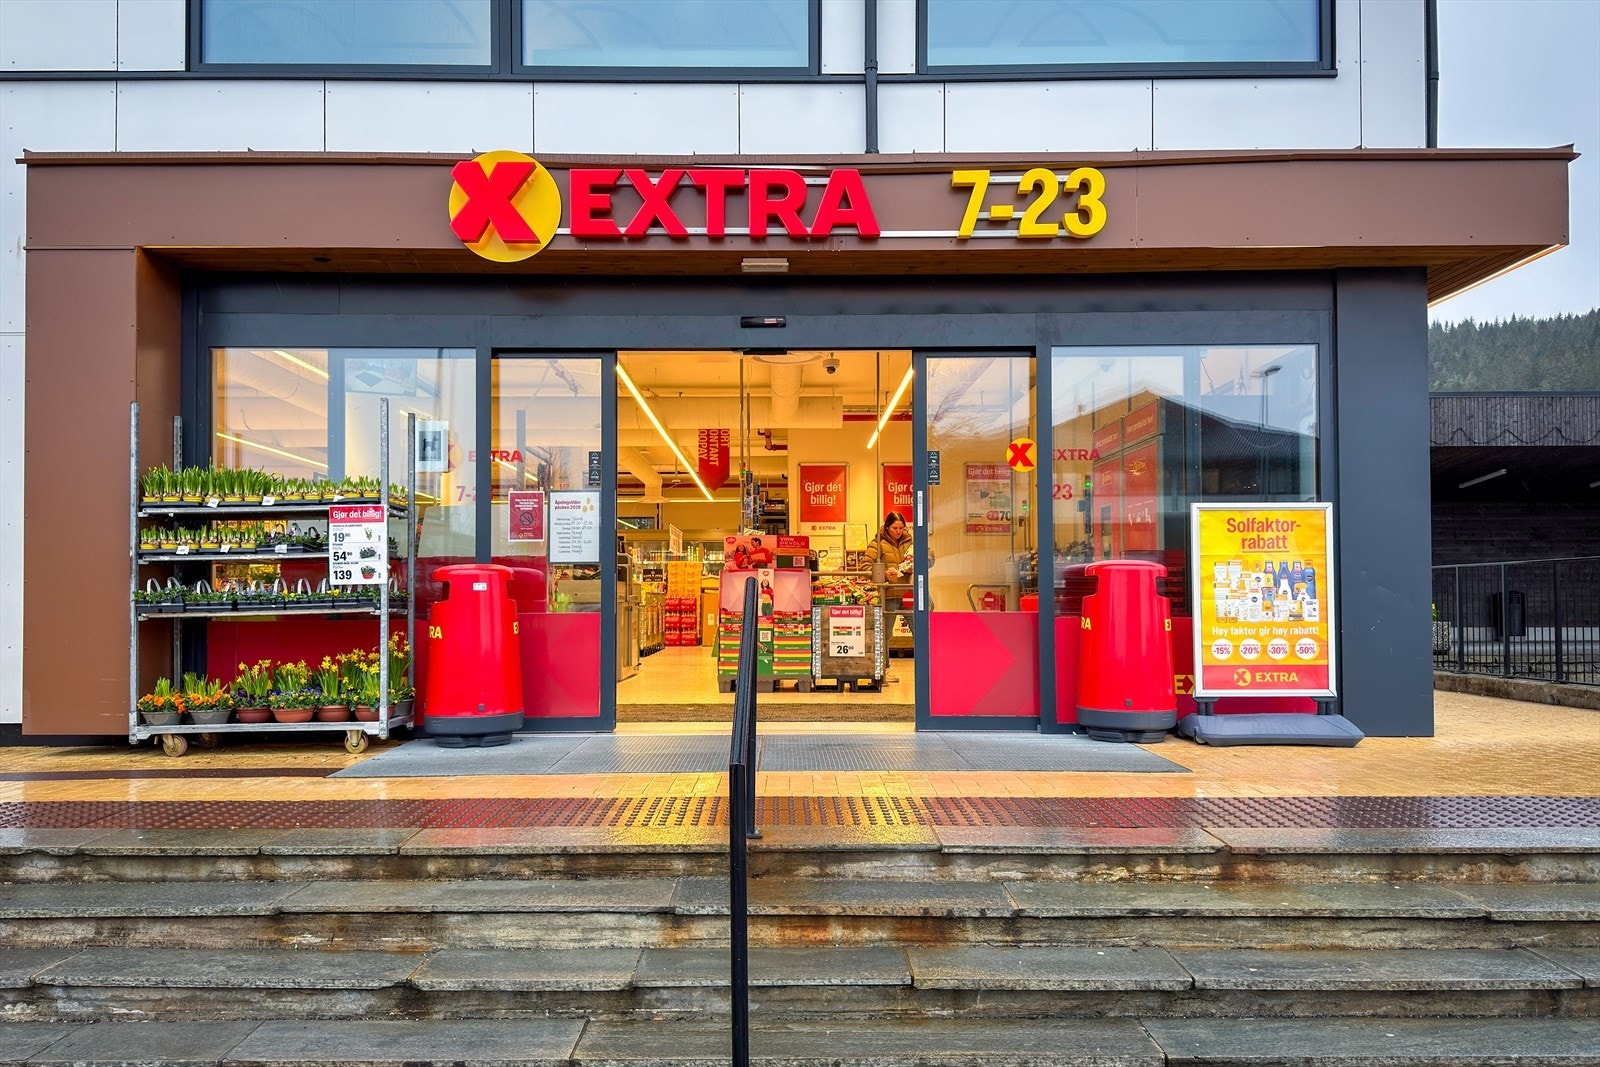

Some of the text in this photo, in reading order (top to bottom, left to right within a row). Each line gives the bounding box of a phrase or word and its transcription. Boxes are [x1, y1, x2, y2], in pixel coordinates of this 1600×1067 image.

[449, 161, 1107, 244] X EXTRA 7-23
[698, 429, 708, 460] OOPAY
[720, 429, 730, 447] ORT
[709, 429, 719, 466] ONTANT
[467, 450, 524, 463] ETRA
[982, 467, 993, 475] det
[805, 482, 842, 494] Gjør det
[888, 482, 907, 494] Gjør
[1052, 484, 1072, 500] 23
[810, 494, 836, 506] billig!
[333, 511, 348, 520] Gjør
[349, 510, 361, 518] det
[1226, 517, 1301, 533] Solfaktor-
[1241, 534, 1288, 549] rabatt
[333, 570, 352, 580] 139
[1081, 617, 1091, 630] RA
[428, 625, 443, 639] RA
[1212, 626, 1319, 636] Høy faktor gir høy rabatt!
[1268, 647, 1288, 655] -30%
[1296, 646, 1316, 654] -50%
[1255, 672, 1299, 682] EXTRA
